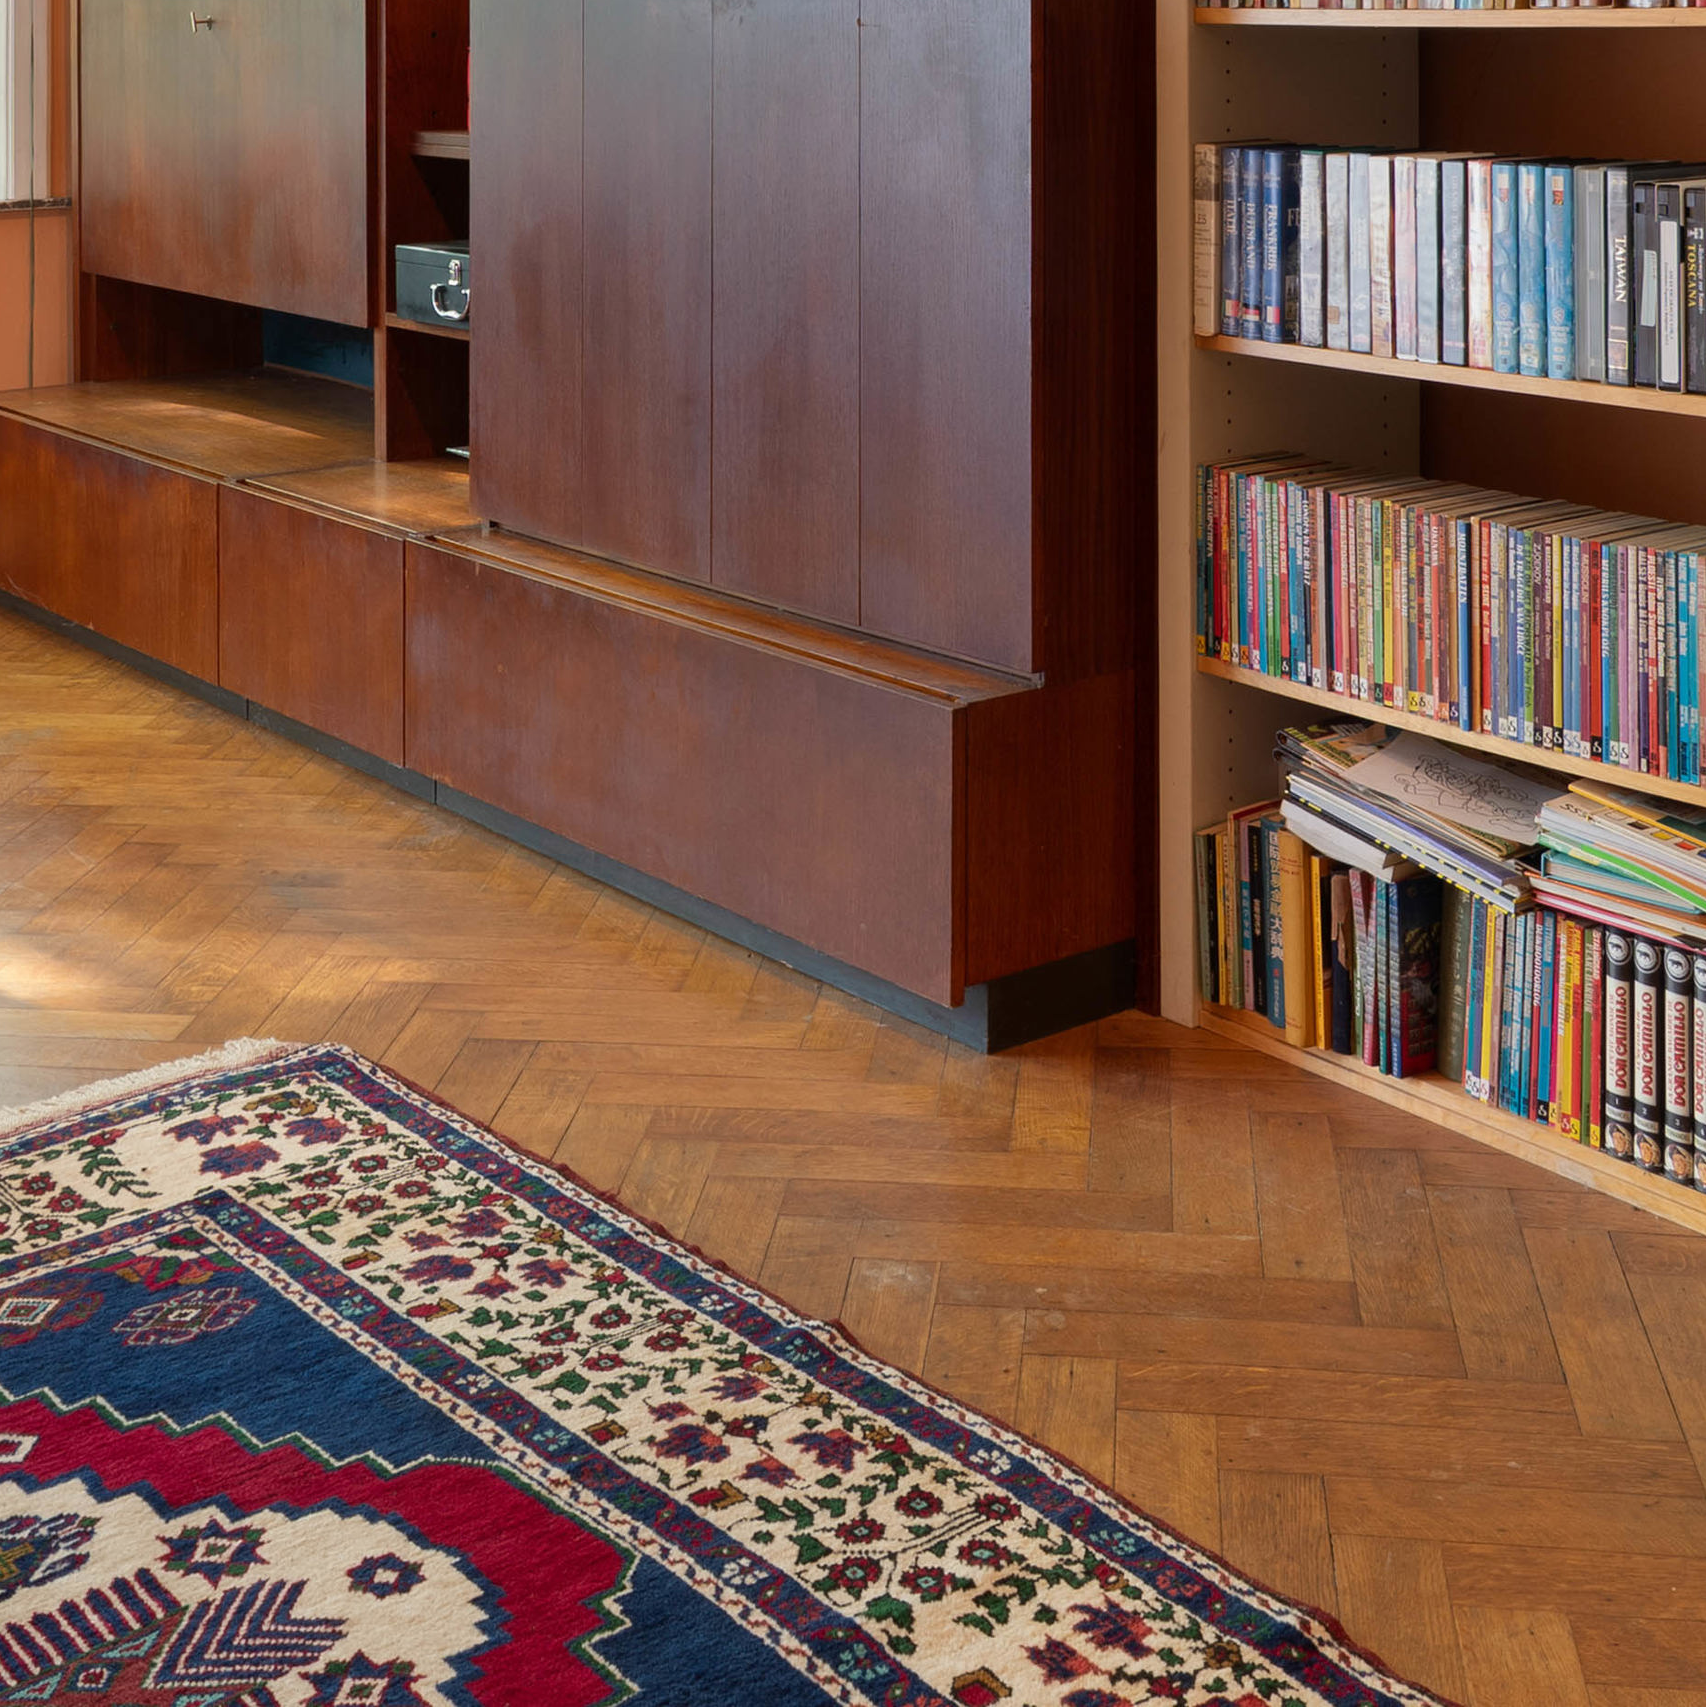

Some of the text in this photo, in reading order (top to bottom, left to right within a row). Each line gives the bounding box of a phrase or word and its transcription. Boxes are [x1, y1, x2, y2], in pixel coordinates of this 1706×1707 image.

[1613, 234, 1627, 303] TAIWAN
[1687, 244, 1698, 309] TOSCANA
[1615, 986, 1627, 1090] DON CAMILLO
[1641, 992, 1653, 1097] DON CAMILLO
[1672, 1001, 1685, 1108] DON CAMILLO
[1695, 1007, 1706, 1115] DON CAMILLO
